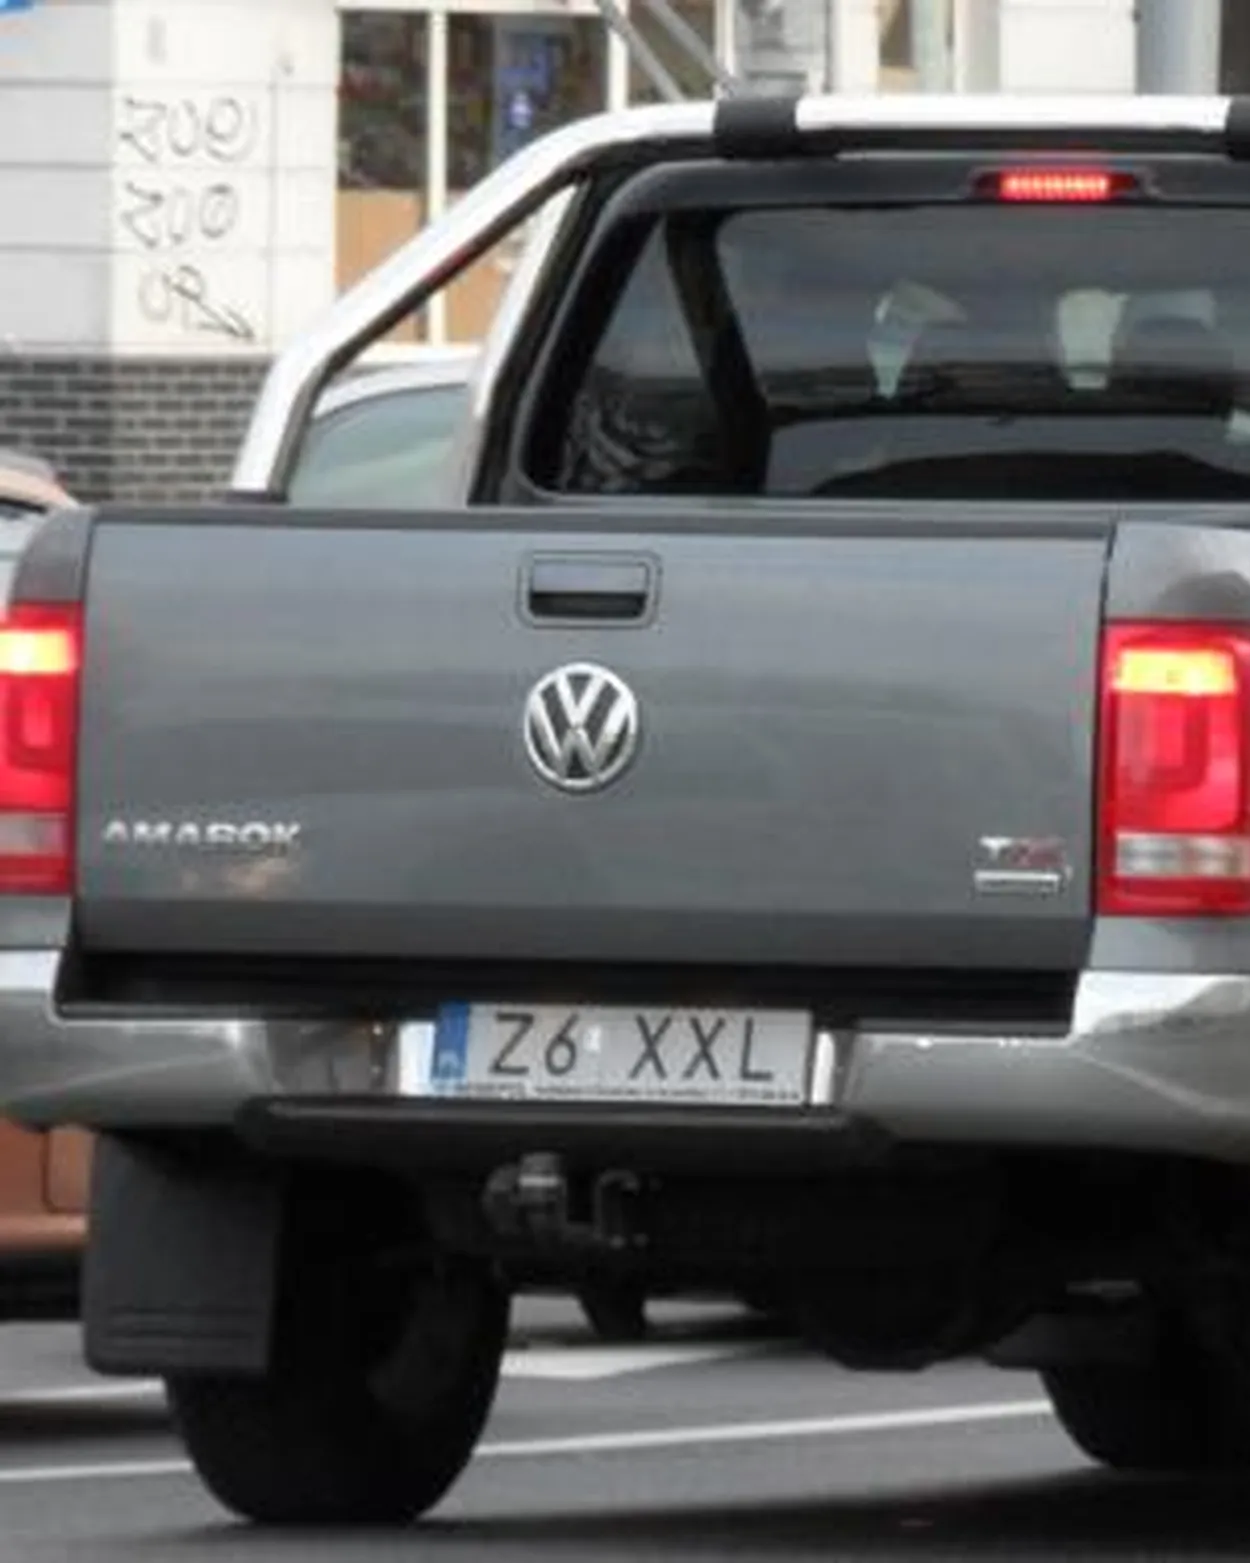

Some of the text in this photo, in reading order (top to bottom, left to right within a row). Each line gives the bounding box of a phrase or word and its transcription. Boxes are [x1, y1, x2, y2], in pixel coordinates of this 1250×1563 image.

[524, 661, 638, 790] VW
[103, 820, 302, 847] AMAROK
[488, 1011, 580, 1077] Z6
[627, 1013, 774, 1082] XXL
